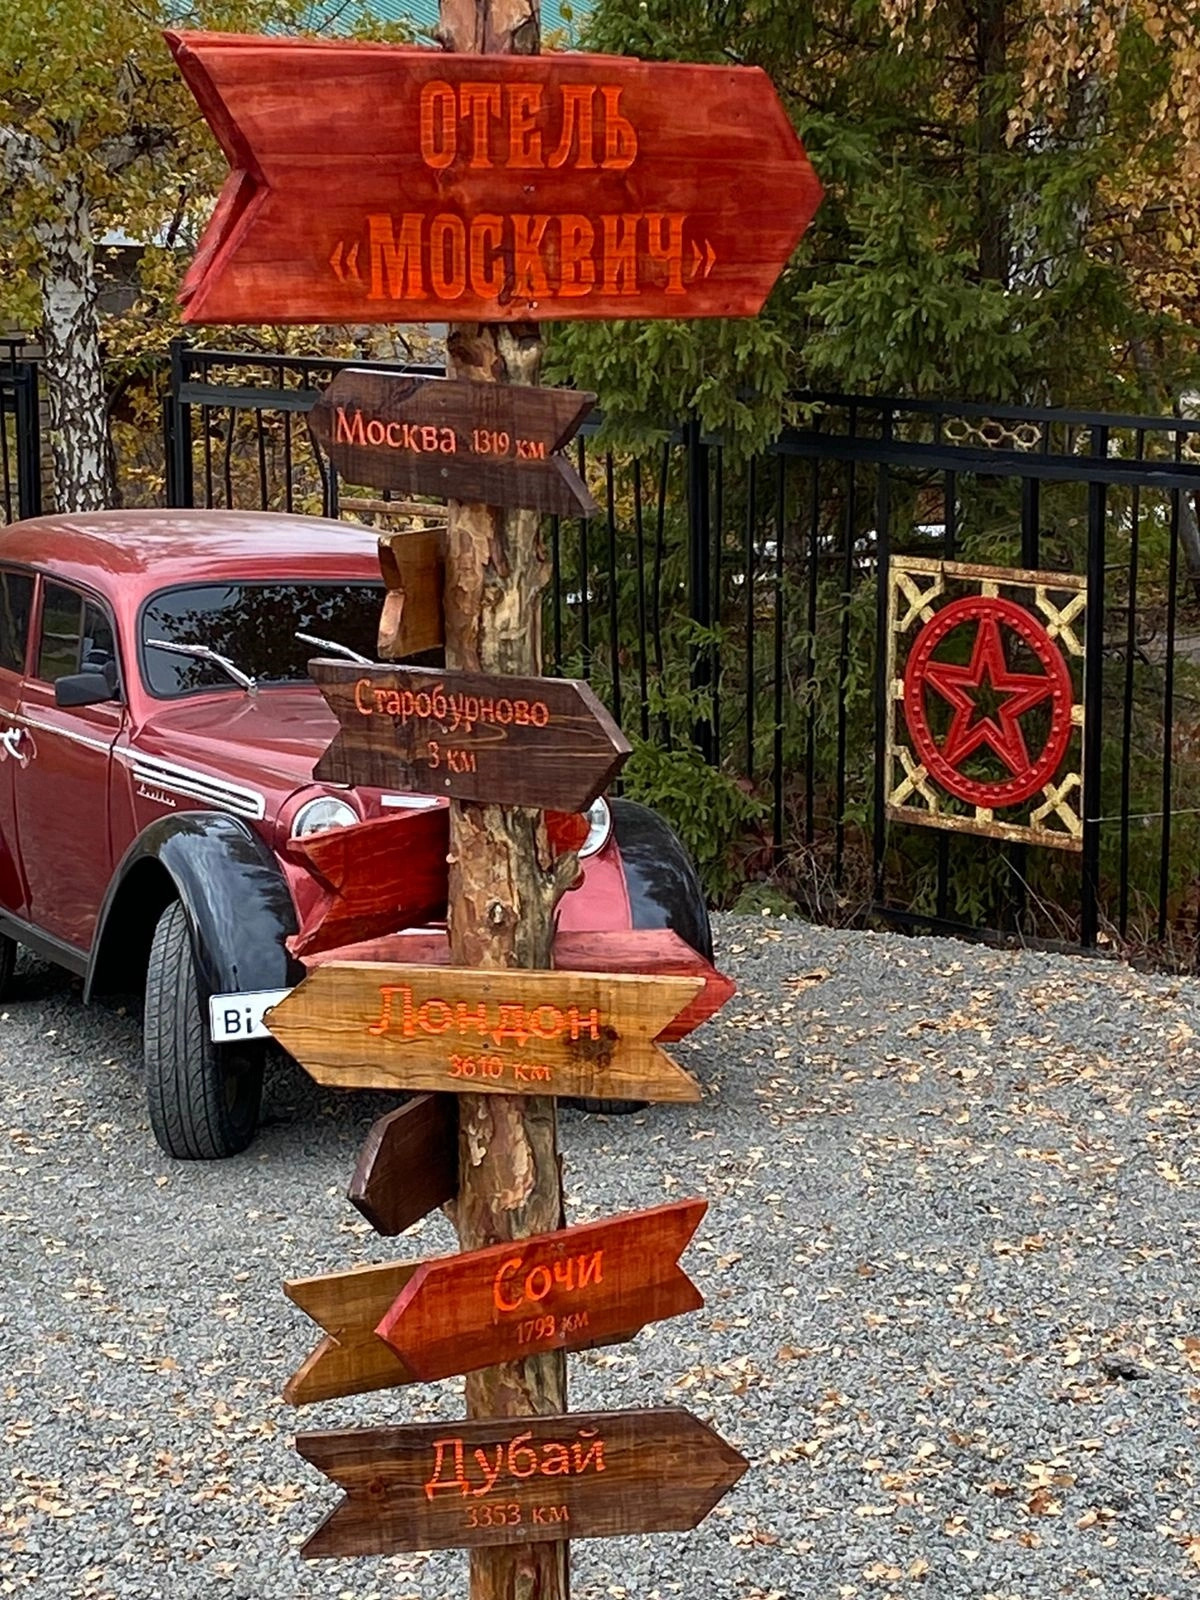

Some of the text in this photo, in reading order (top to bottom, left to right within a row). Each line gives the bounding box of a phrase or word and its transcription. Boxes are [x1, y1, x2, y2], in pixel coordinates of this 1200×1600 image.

[420, 80, 638, 169] ОТЕЛЬ
[329, 212, 717, 300] «МОСКВИЧ»
[336, 407, 545, 460] Москва 1319 км
[355, 679, 549, 733] Старобурново
[427, 741, 477, 773] 3 км
[368, 984, 600, 1047] Лондон
[448, 1054, 552, 1082] 3610 км
[493, 1250, 604, 1312] Сочи
[517, 1311, 589, 1344] 1793 км
[424, 1427, 606, 1500] Дубай
[465, 1504, 571, 1529] 3353 км
